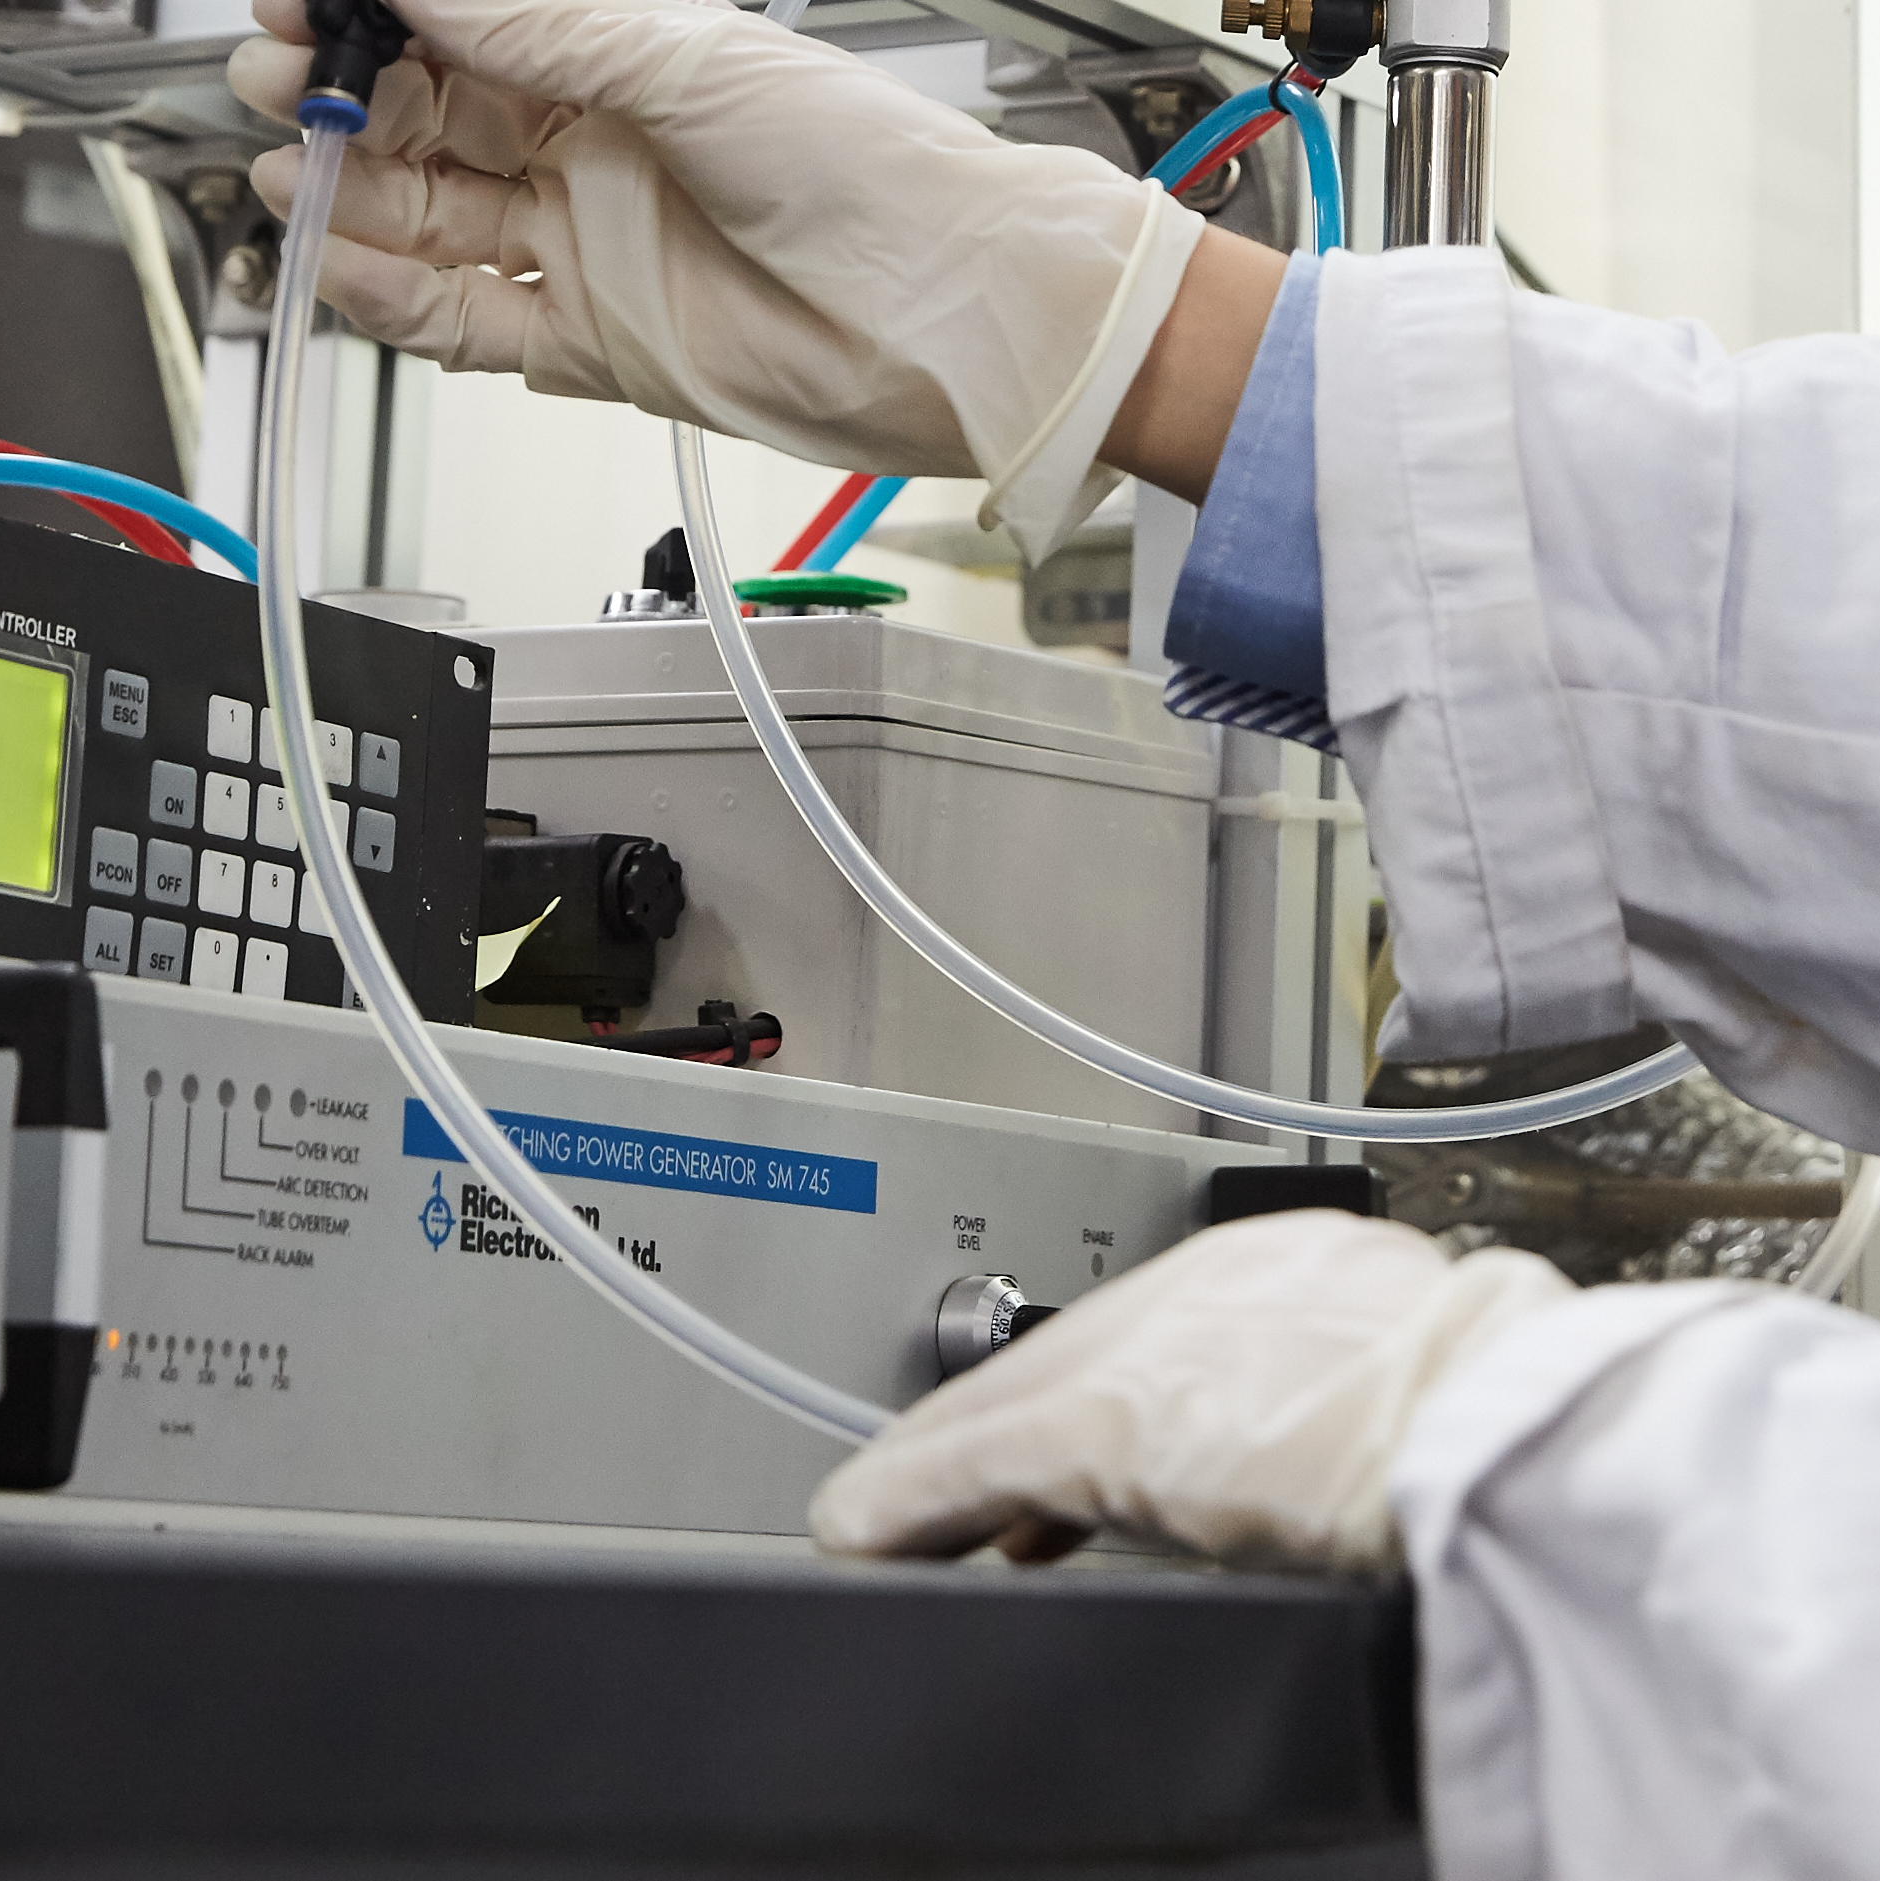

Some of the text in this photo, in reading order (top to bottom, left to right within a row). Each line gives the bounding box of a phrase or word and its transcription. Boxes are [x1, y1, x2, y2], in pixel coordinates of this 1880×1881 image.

[108, 681, 145, 705] MENU
[112, 705, 139, 726] ESC
[329, 733, 337, 747] 3
[225, 785, 233, 800] 4
[164, 796, 184, 816] ON
[277, 797, 285, 811] 5
[96, 861, 133, 884] PCON
[220, 863, 228, 877] 7
[156, 873, 183, 894] OFF
[271, 873, 279, 888] 8
[94, 942, 121, 963] ALL
[213, 940, 221, 955] 0
[149, 952, 175, 973] SET
[317, 1098, 369, 1120] LEAKAGE
[295, 1140, 360, 1164] OVER VOLT
[577, 1136, 644, 1173] POWER
[649, 1145, 757, 1187] GENERATOR
[767, 1162, 793, 1191] SM
[799, 1166, 831, 1196] 745
[276, 1175, 368, 1202] ARC DETECTION
[258, 1208, 286, 1229] TUBE
[953, 1214, 986, 1233] POWER
[957, 1234, 982, 1251] LEVEL
[1082, 1227, 1115, 1247] ENABLE
[273, 1248, 315, 1268] ALARM
[998, 1318, 1011, 1335] 60
